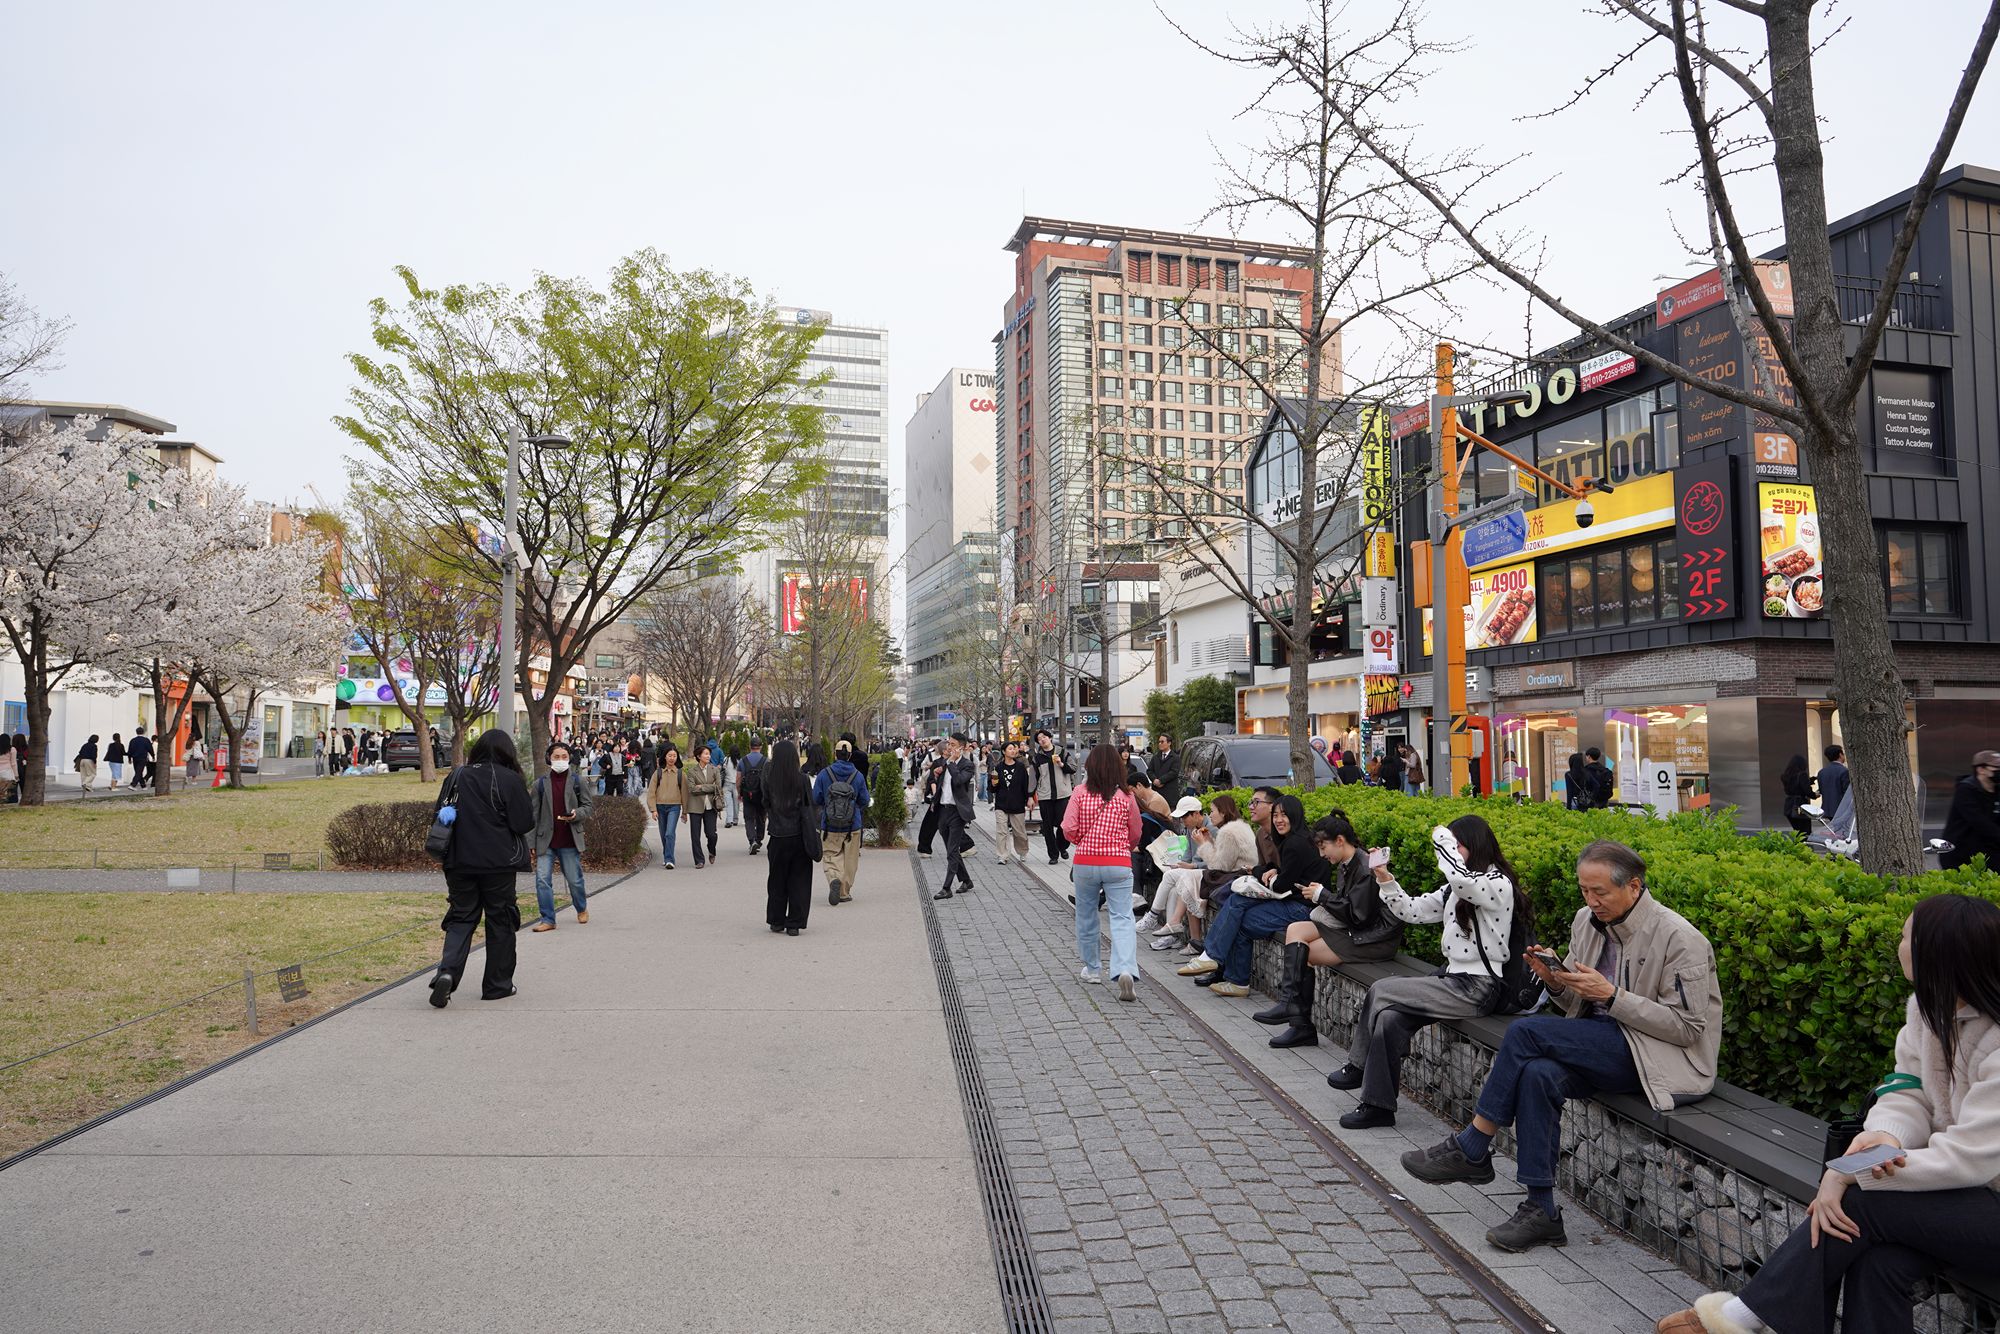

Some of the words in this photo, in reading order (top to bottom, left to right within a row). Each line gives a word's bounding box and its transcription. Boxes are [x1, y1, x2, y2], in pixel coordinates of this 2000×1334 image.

[960, 373, 973, 387] LC
[1591, 362, 1634, 385] 010-2259-9599
[969, 399, 997, 413] CGV
[1877, 396, 1910, 407] Permanent
[1911, 399, 1936, 409] Makeup
[1886, 411, 1906, 420] Henna
[1907, 412, 1928, 421] Tattoo
[1885, 423, 1909, 433] Custom
[1910, 425, 1931, 435] Design
[1763, 436, 1789, 461] 3F
[1884, 437, 1904, 446] Tattoo
[1905, 439, 1933, 449] Academy
[1755, 464, 1767, 474] 010
[1772, 498, 1808, 516] 균일가
[1689, 568, 1722, 597] 2F
[1379, 584, 1388, 621] Ordinary.
[1463, 612, 1474, 621] EGA
[1370, 630, 1394, 661] 약
